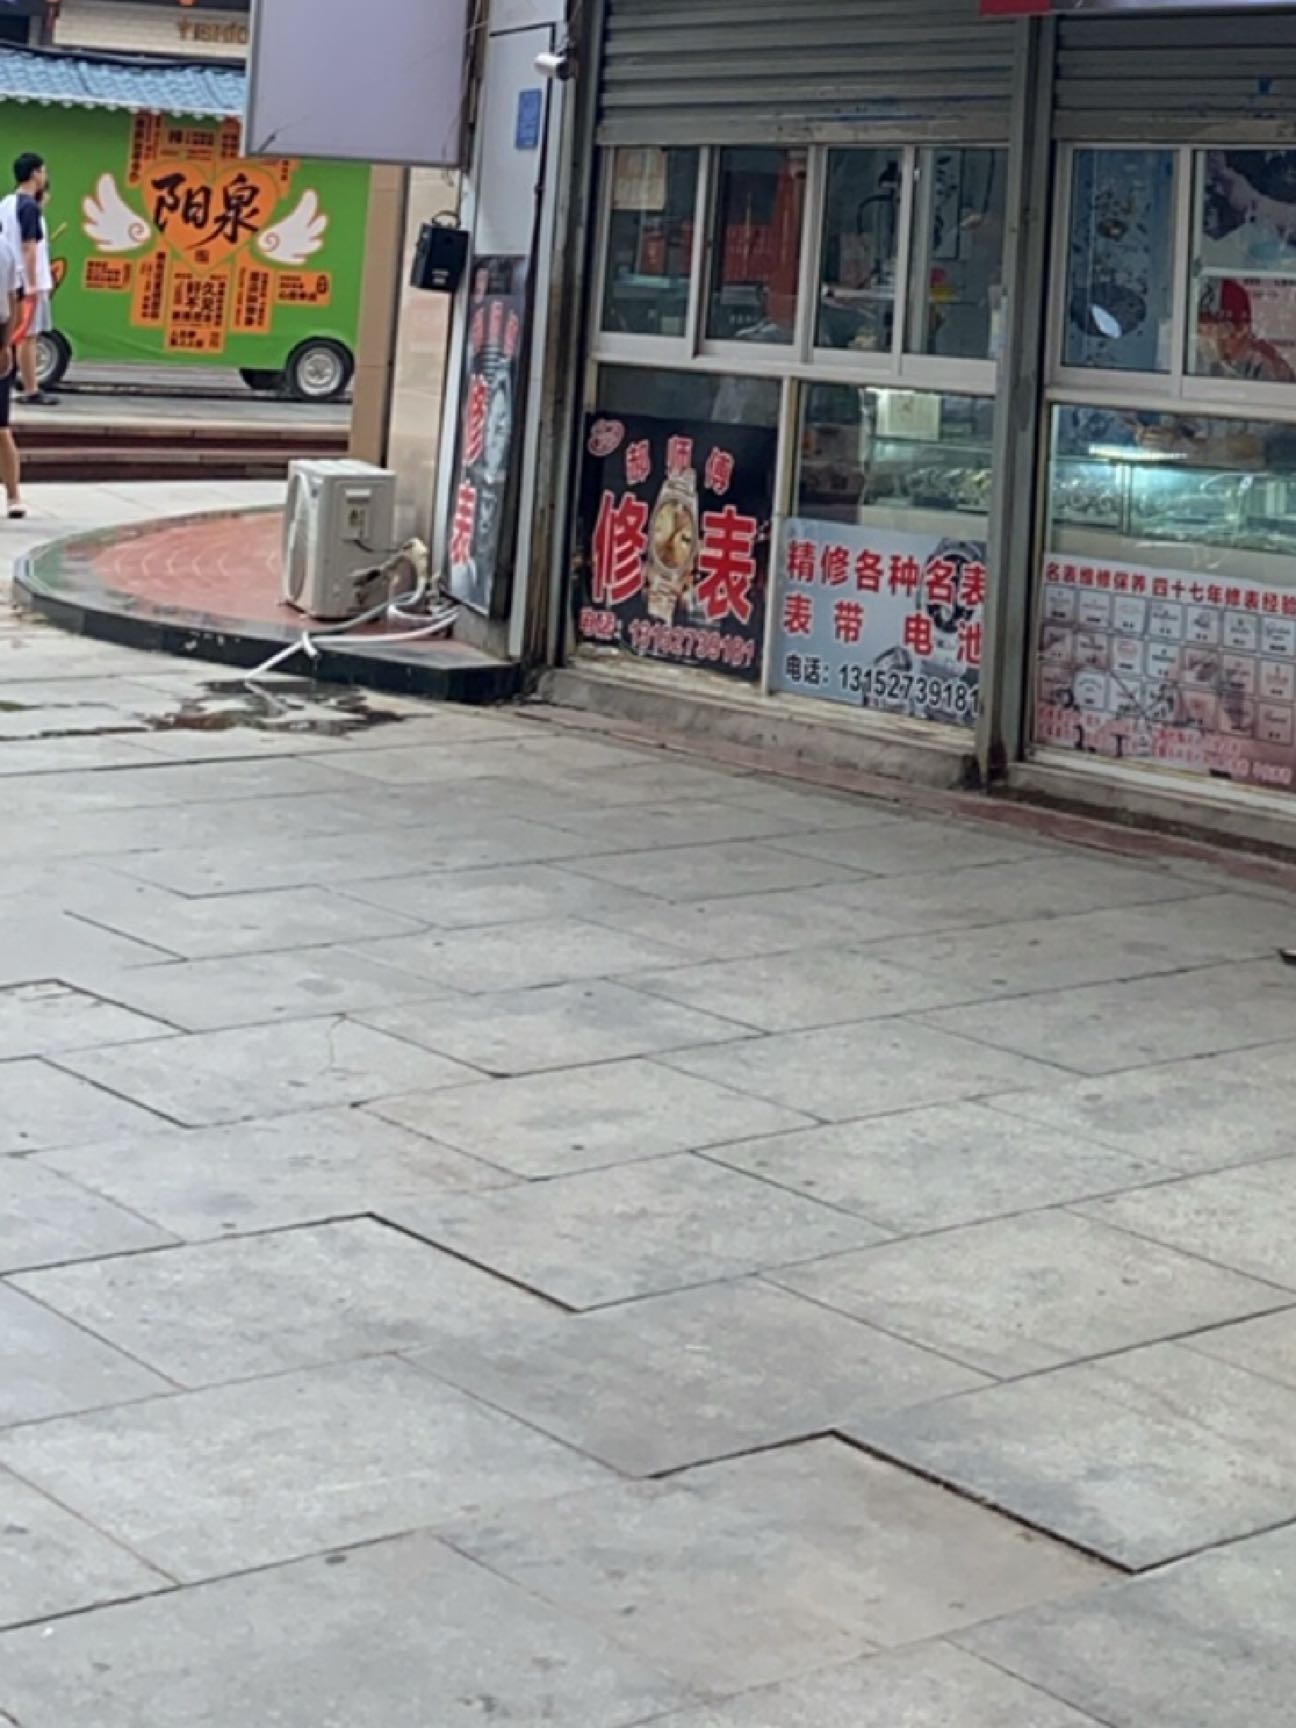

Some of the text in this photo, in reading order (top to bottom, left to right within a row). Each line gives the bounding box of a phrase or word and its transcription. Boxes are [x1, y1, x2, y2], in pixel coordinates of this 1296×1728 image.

[151, 172, 260, 250] 阳泉
[591, 489, 758, 625] 修表
[786, 540, 986, 605] 精修各种名表
[784, 594, 983, 665] 表带 电池
